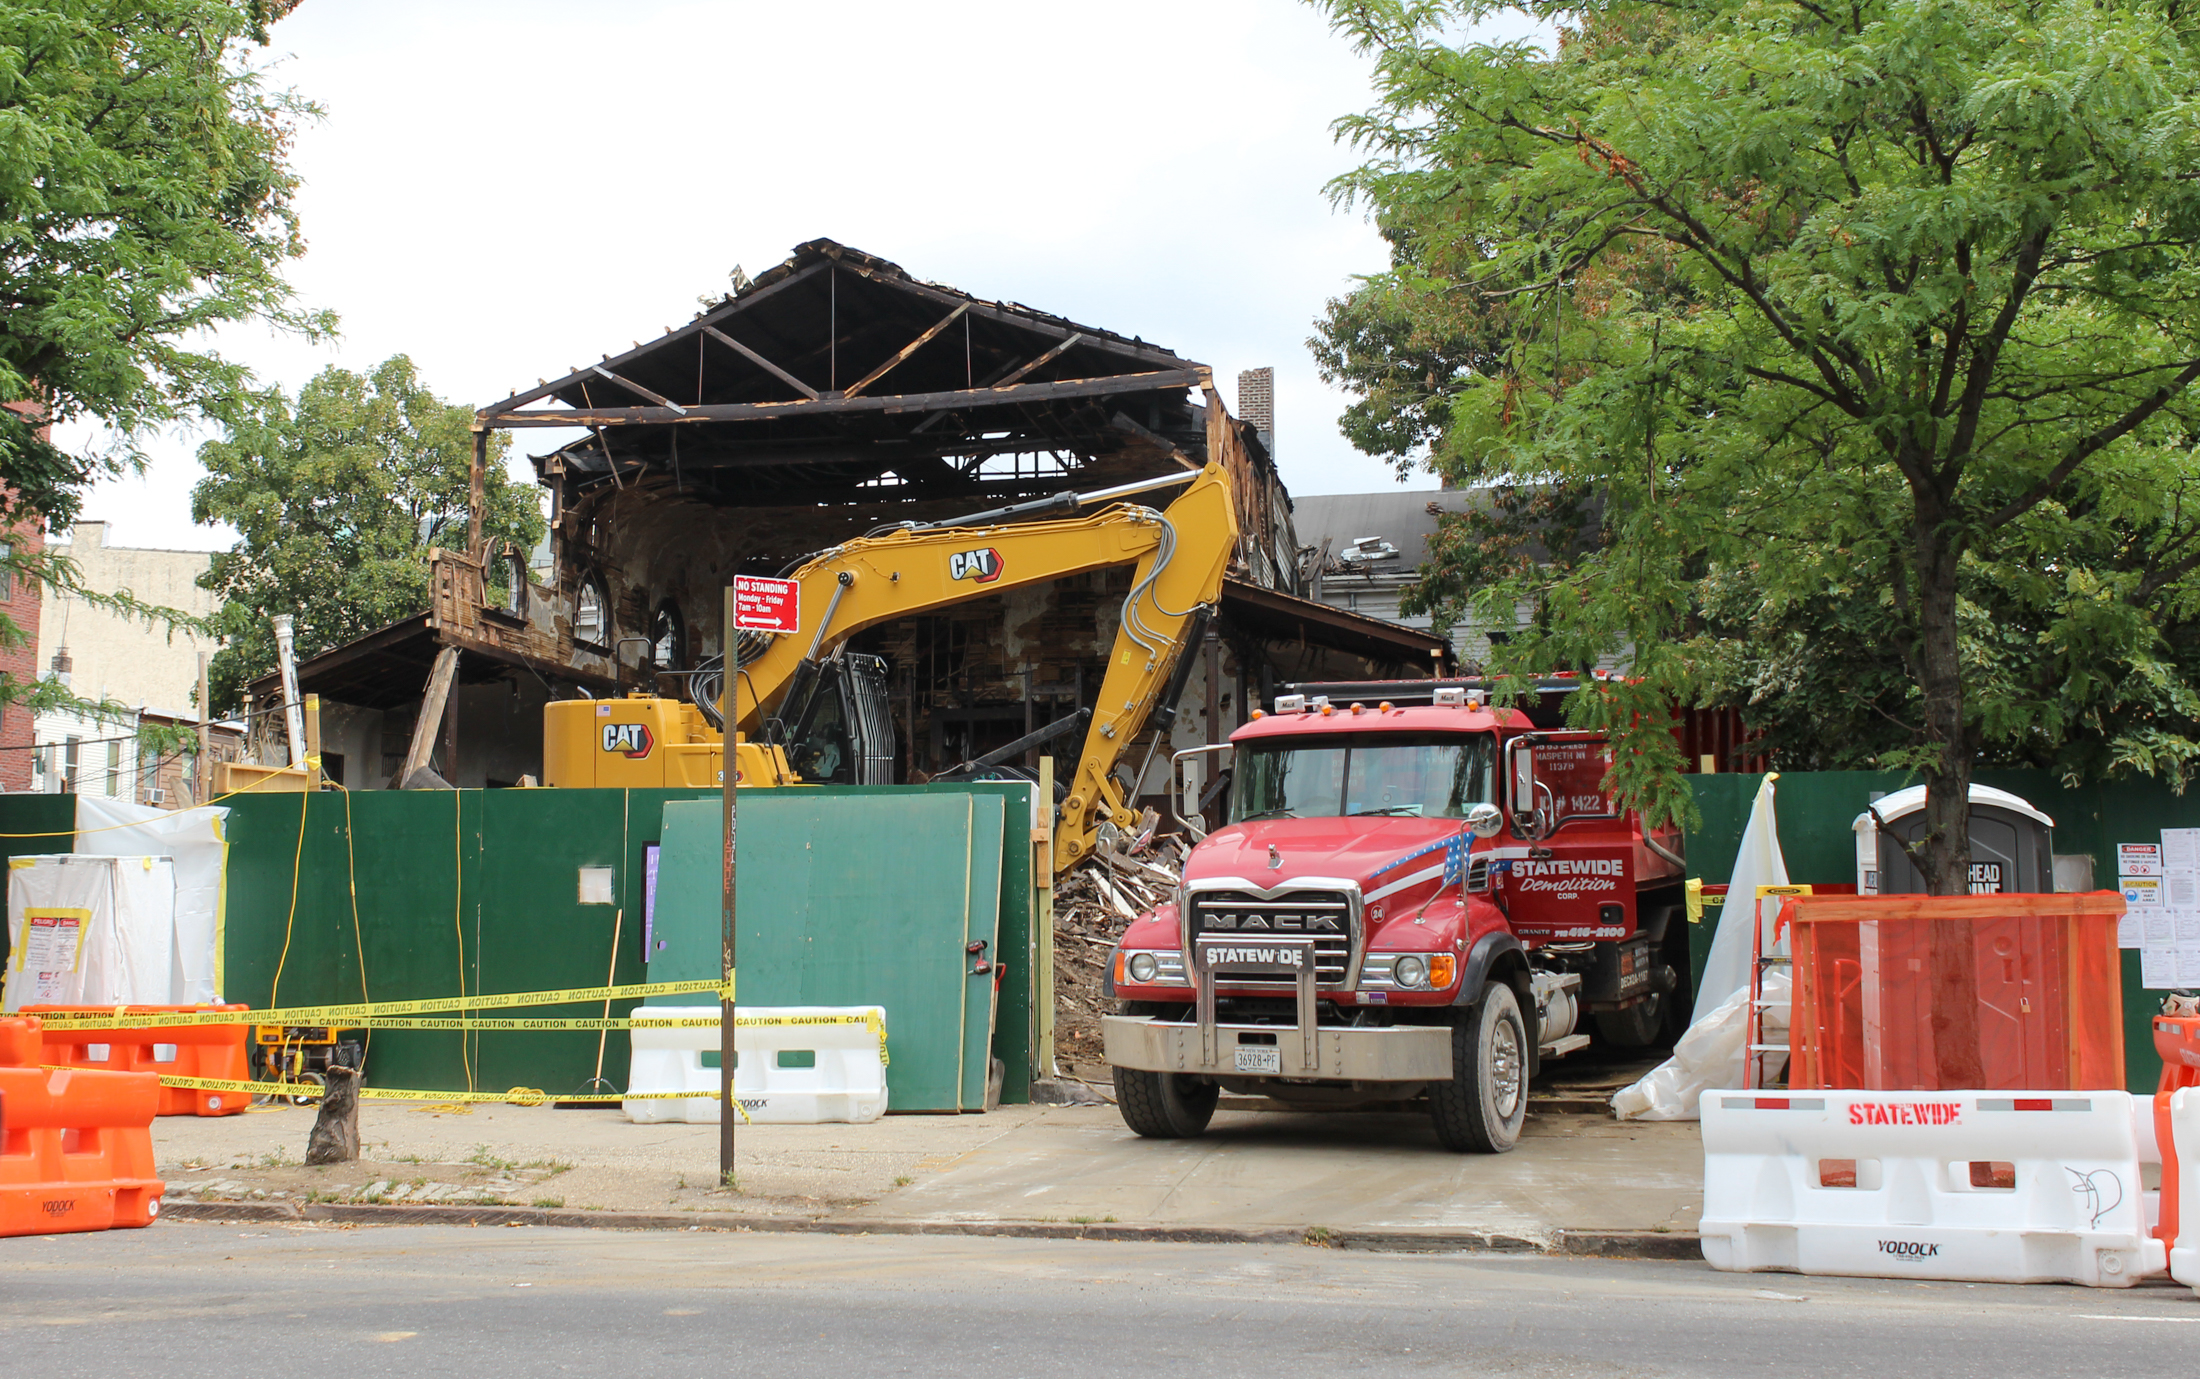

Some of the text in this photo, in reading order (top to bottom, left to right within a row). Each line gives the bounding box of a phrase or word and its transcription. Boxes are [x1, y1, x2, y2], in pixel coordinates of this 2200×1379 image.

[949, 548, 990, 581] CAT
[738, 580, 788, 595] NO STANDING
[738, 593, 761, 603] Monday
[765, 595, 784, 606] Friday
[738, 602, 751, 612] 7am
[755, 604, 771, 613] 10am
[603, 724, 642, 752] CAT
[1536, 751, 1573, 760] MASPETH
[1571, 795, 1600, 811] 1422
[1512, 859, 1624, 877] STATEWIDE
[1520, 877, 1616, 892] Demolition
[1373, 909, 1383, 919] 24
[1204, 914, 1340, 930] MACK
[319, 1018, 361, 1026] CAUTION
[369, 1019, 412, 1027] CAUTION
[420, 1019, 463, 1028] CAUTION
[471, 1019, 515, 1028] CAUTION
[523, 1020, 567, 1028] CAUTION
[575, 1019, 619, 1028] CAUTION
[627, 1019, 672, 1028] CAUTION
[736, 1016, 782, 1026] CAUTION
[790, 1015, 837, 1025] CAUTION
[1238, 1053, 1276, 1068] 36928 PF
[159, 1076, 195, 1087] CAUTION
[200, 1079, 237, 1090] CAUTION
[241, 1082, 280, 1093] CAUTION
[285, 1085, 324, 1095] CAUTION
[737, 1098, 767, 1108] ODOCK
[1848, 1102, 1962, 1126] STATEWIDE
[42, 1199, 76, 1213] YODOCK
[1877, 1239, 1940, 1256] YODOCK
